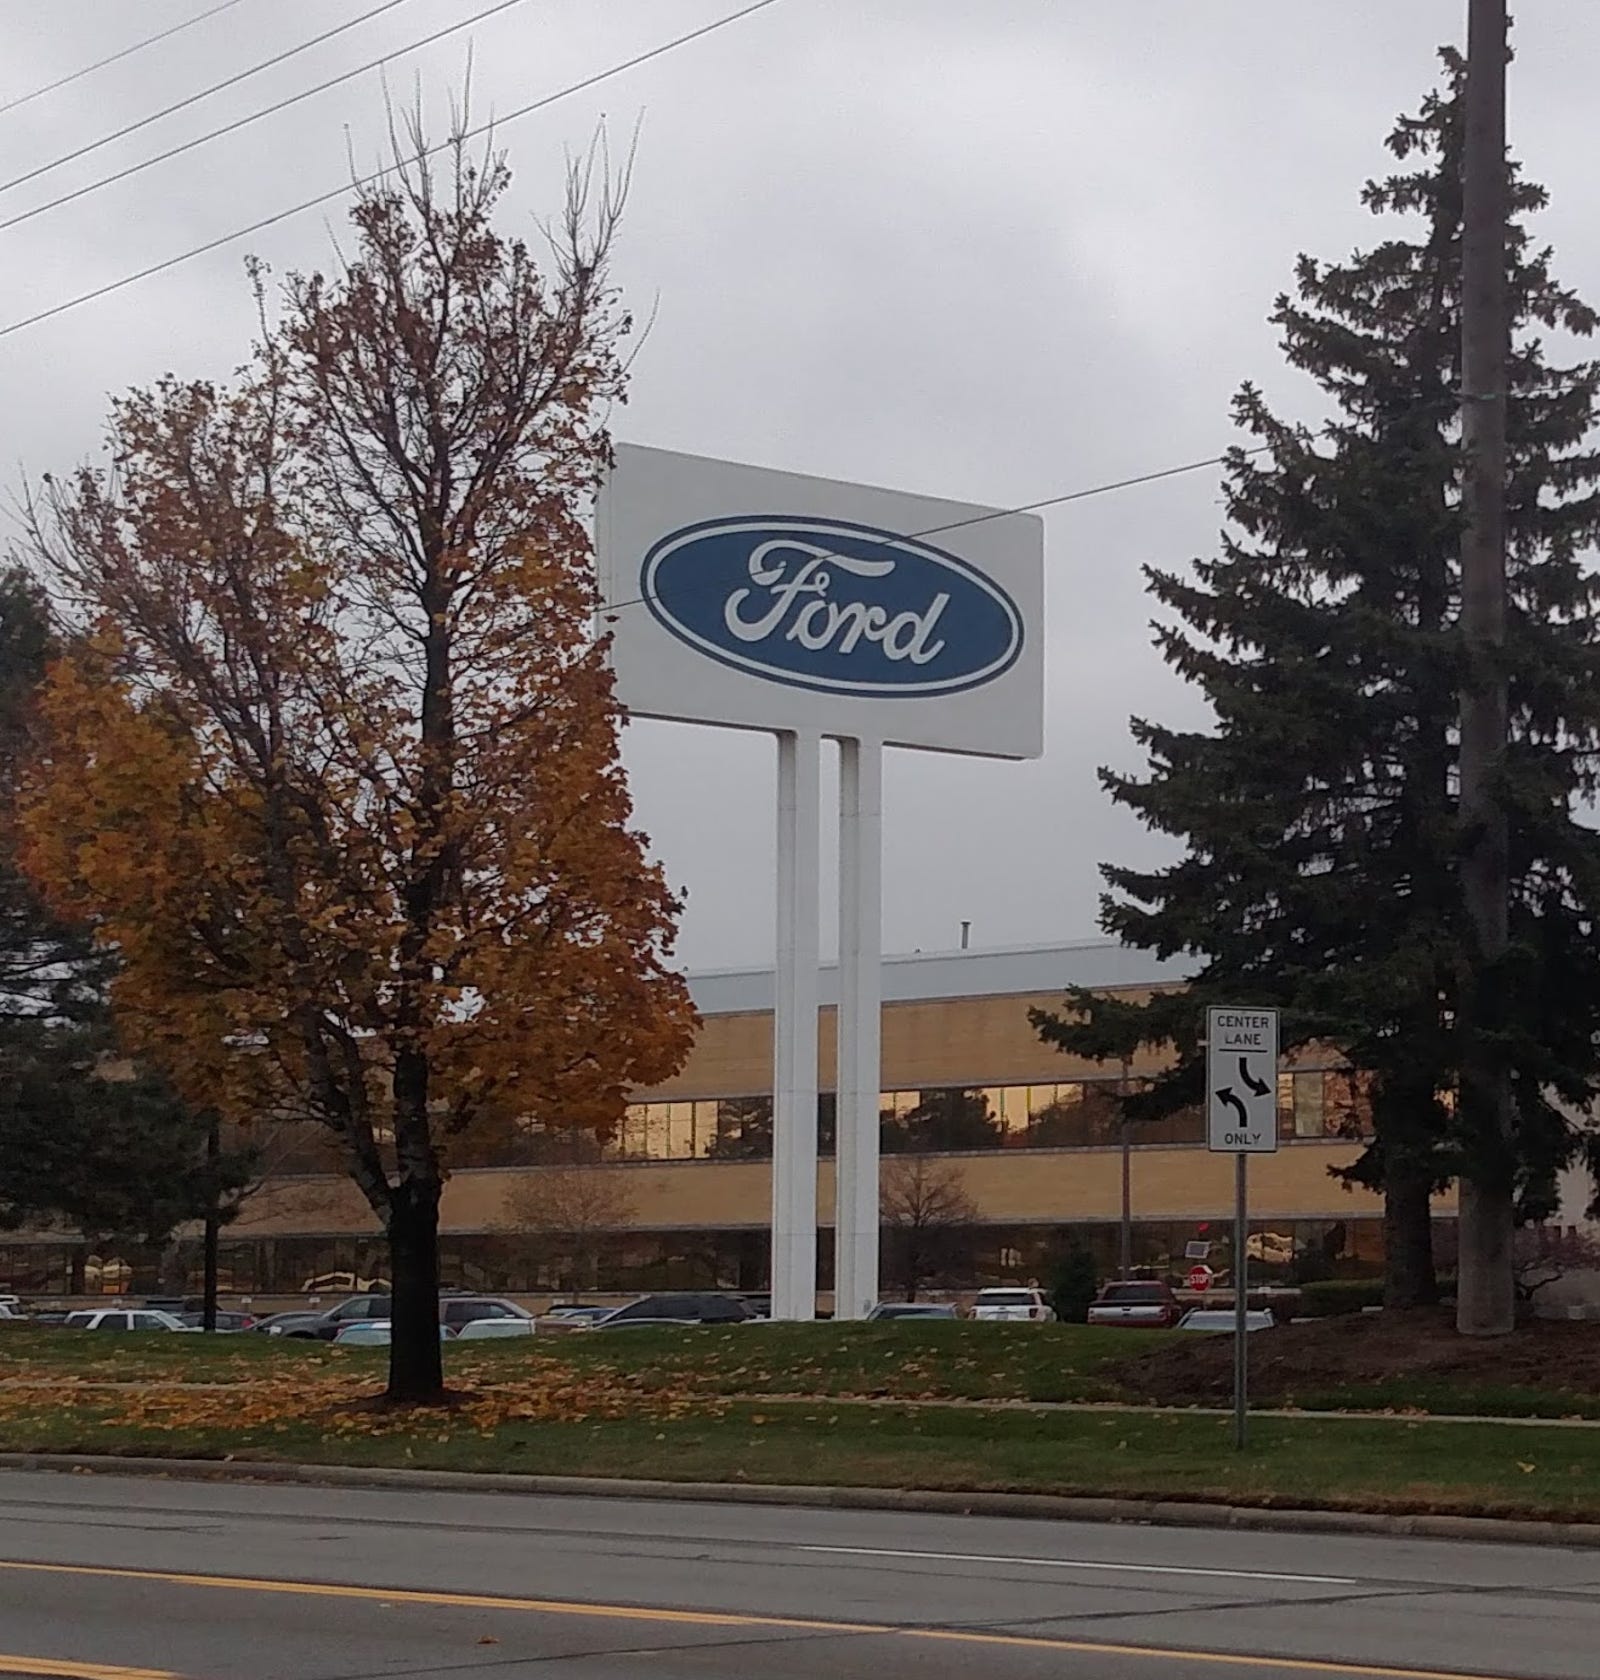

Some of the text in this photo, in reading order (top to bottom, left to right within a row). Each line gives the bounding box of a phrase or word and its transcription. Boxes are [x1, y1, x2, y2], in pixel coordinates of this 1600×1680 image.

[724, 539, 950, 665] Ford
[1217, 1015, 1269, 1029] CENTER
[1224, 1033, 1262, 1046] LANE
[1224, 1132, 1262, 1145] ONLY
[1191, 1274, 1209, 1285] STOP
